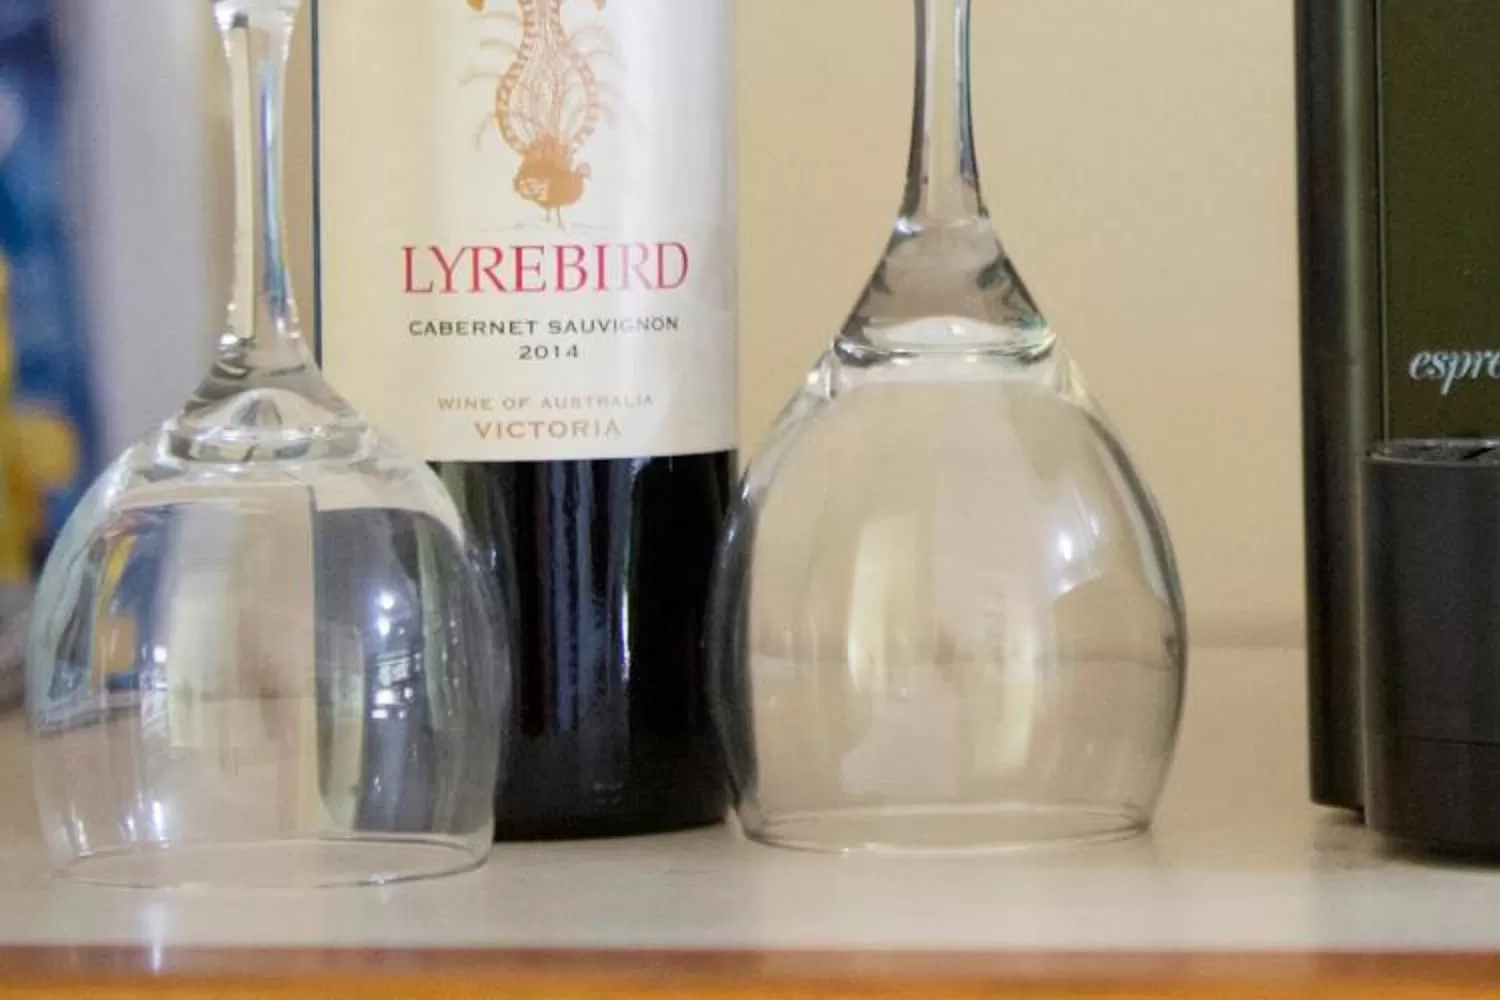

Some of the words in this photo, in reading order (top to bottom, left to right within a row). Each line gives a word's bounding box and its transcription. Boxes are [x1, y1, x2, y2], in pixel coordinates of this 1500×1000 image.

[402, 242, 689, 293] LYREBIRD
[408, 319, 539, 337] CABERNET
[547, 315, 679, 335] SAUVIGNON
[518, 343, 580, 361] 2014
[437, 395, 493, 412] WINE
[501, 395, 531, 411] OF
[540, 393, 654, 411] AUSTRALIA
[473, 420, 622, 441] VICTORIA
